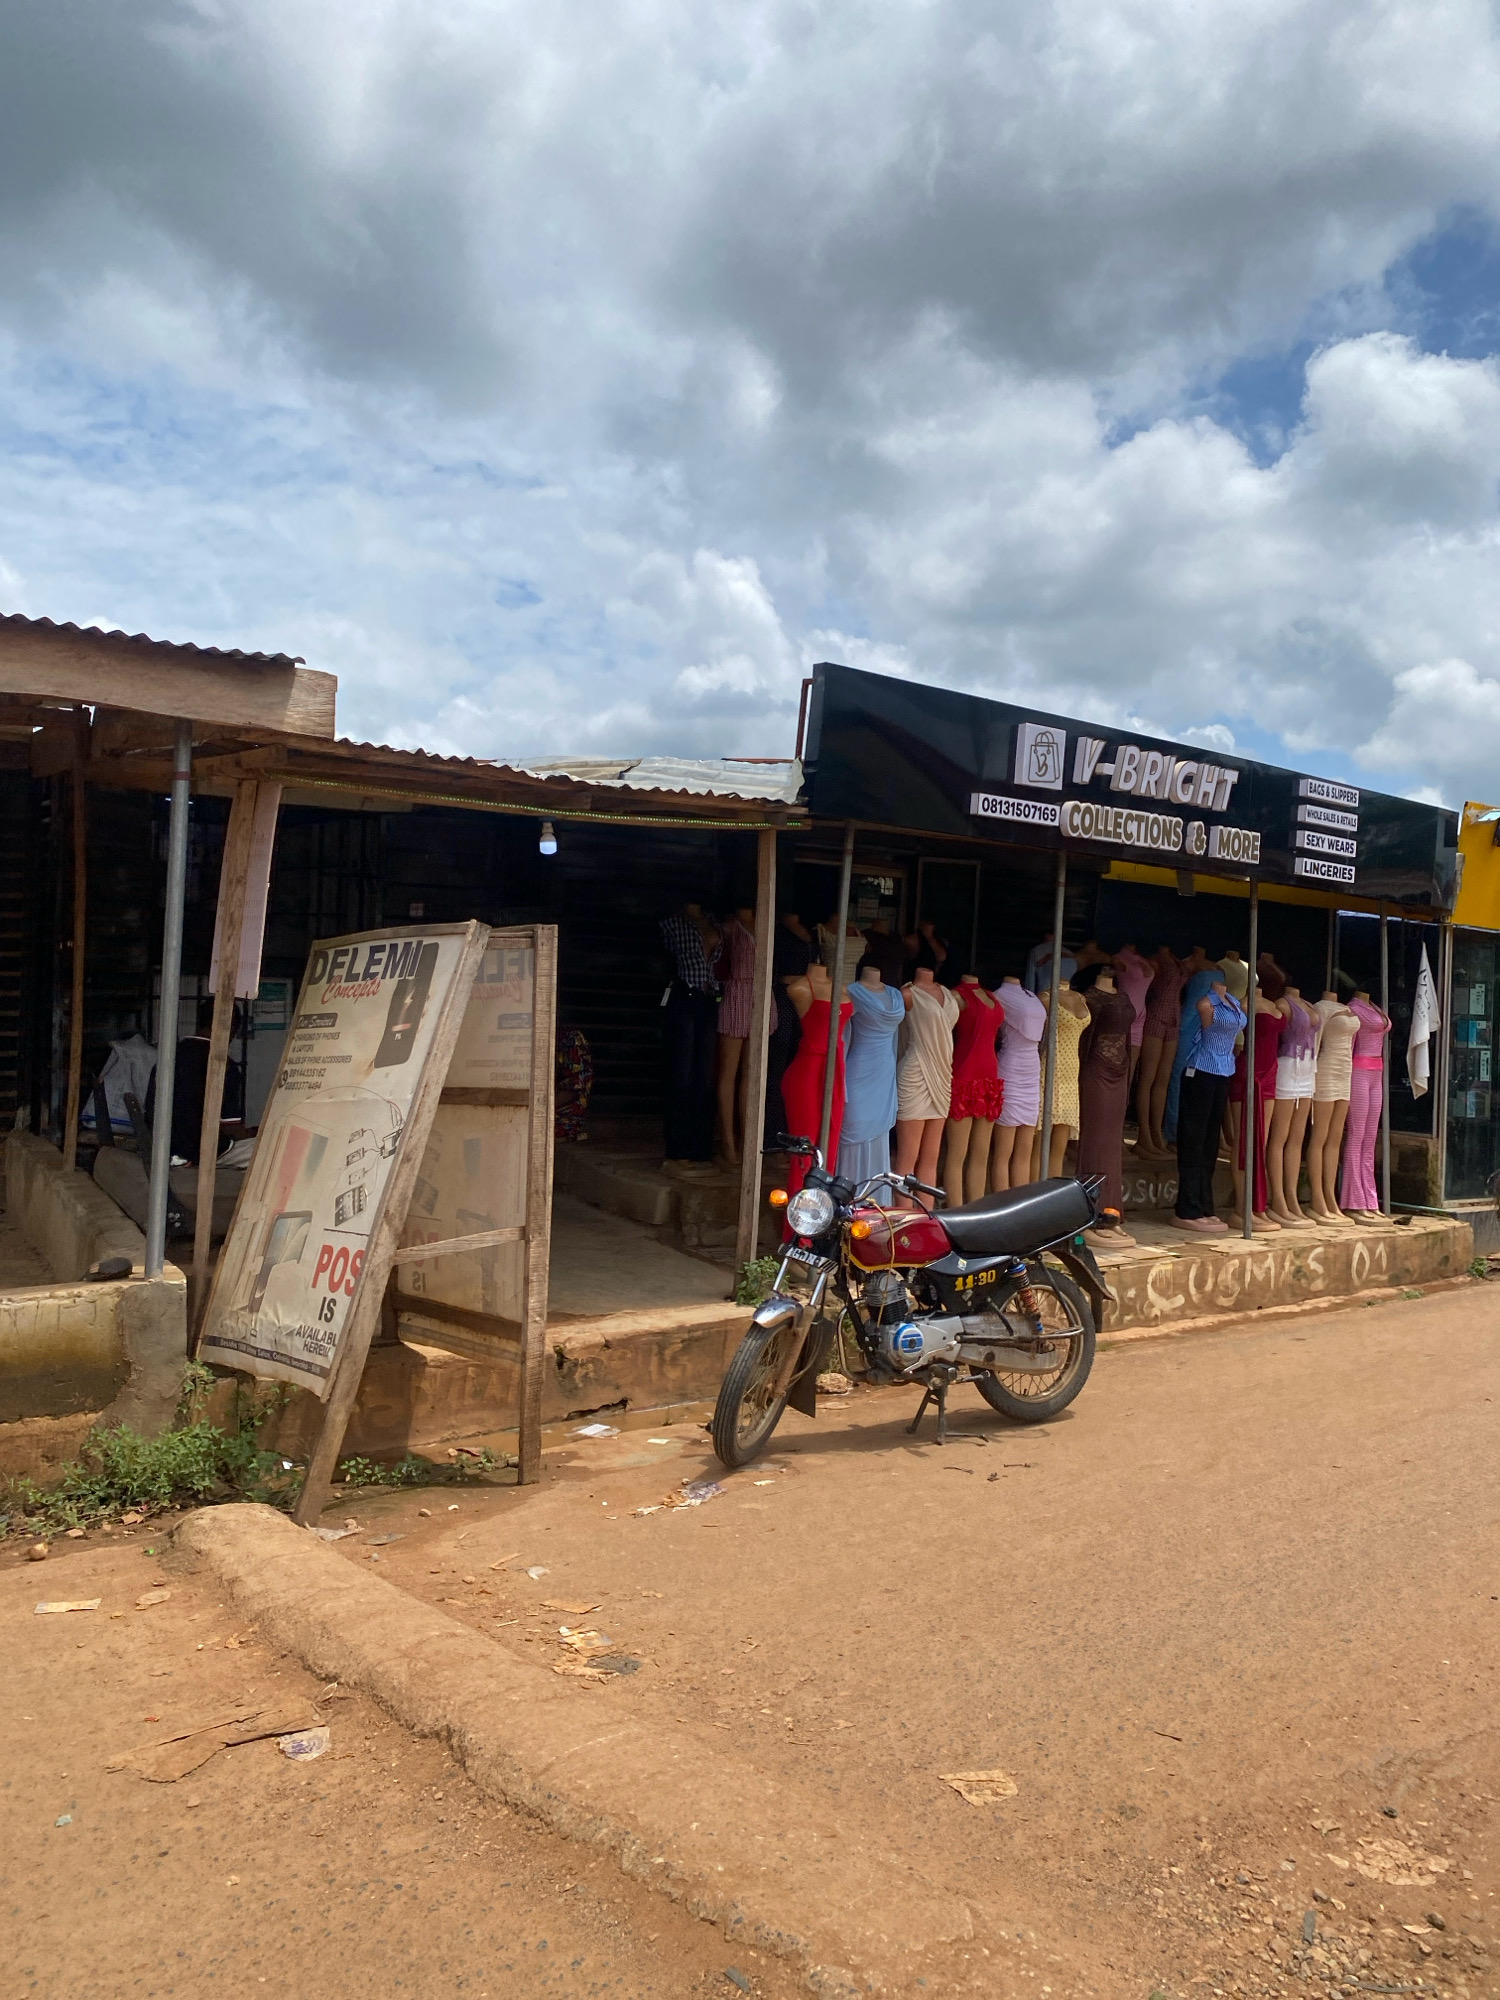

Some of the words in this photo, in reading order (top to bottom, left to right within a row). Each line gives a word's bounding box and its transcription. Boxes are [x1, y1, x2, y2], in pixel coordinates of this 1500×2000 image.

[1074, 736, 1239, 812] V-BRIGHT
[1309, 782, 1325, 797] BAGS
[1331, 787, 1358, 804] SLIPPERS
[981, 797, 1057, 823] 08131507169
[1307, 808, 1323, 821] WHOLE
[1323, 811, 1336, 823] SALES
[1340, 815, 1357, 828] RETAILS
[1066, 802, 1183, 850] COLLECTIONS
[1191, 822, 1207, 855] &
[1216, 827, 1261, 863] MORE
[1306, 833, 1326, 849] SEXY
[1327, 837, 1355, 854] WEARS
[1303, 860, 1353, 881] LINGERIES
[307, 940, 423, 986] DELEMI
[321, 974, 381, 1005] Concepts
[311, 1244, 366, 1297] POS
[954, 1269, 996, 1291] 11:30
[318, 1296, 337, 1323] IS
[295, 1324, 338, 1348] AVAILABL
